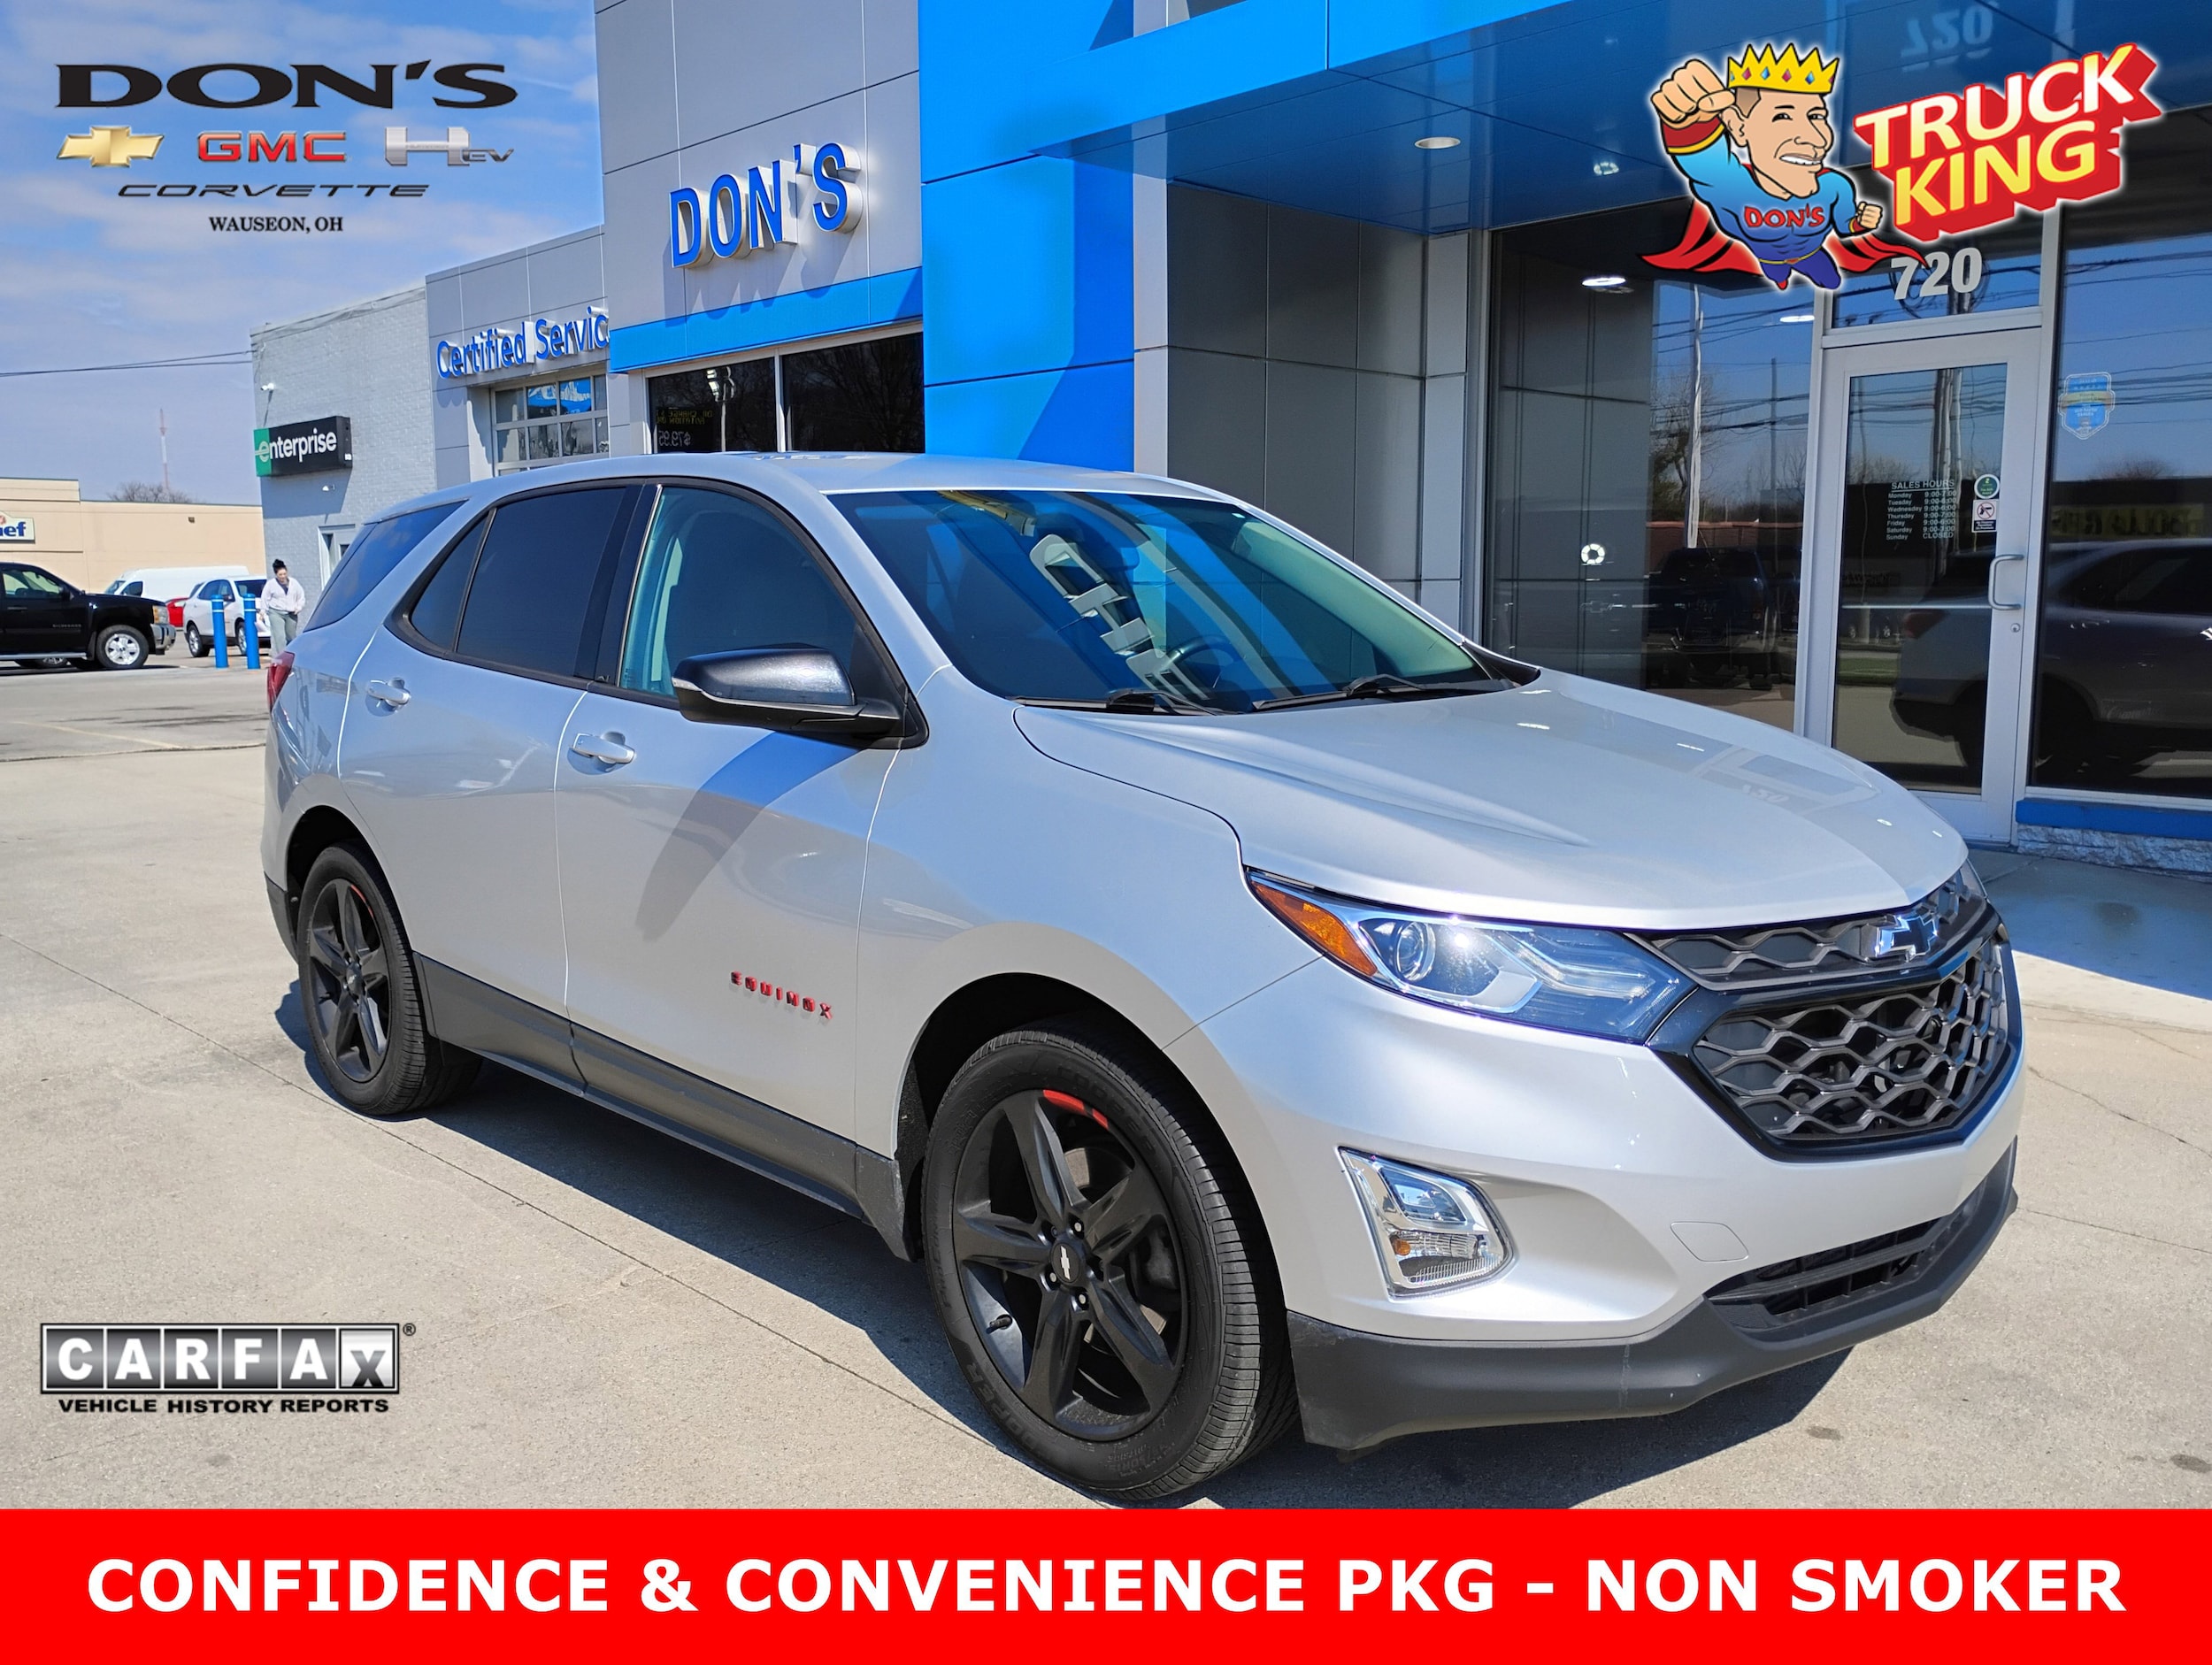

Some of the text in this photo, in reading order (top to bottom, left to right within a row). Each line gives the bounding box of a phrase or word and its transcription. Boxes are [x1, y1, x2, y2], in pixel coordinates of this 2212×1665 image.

[670, 142, 860, 268] DON'S
[1890, 248, 1983, 300] 720
[436, 305, 609, 380] Certified Servic
[255, 427, 337, 463] enterprise
[1892, 479, 1955, 490] SALES HOURS
[731, 971, 833, 1019] EQUINOX
